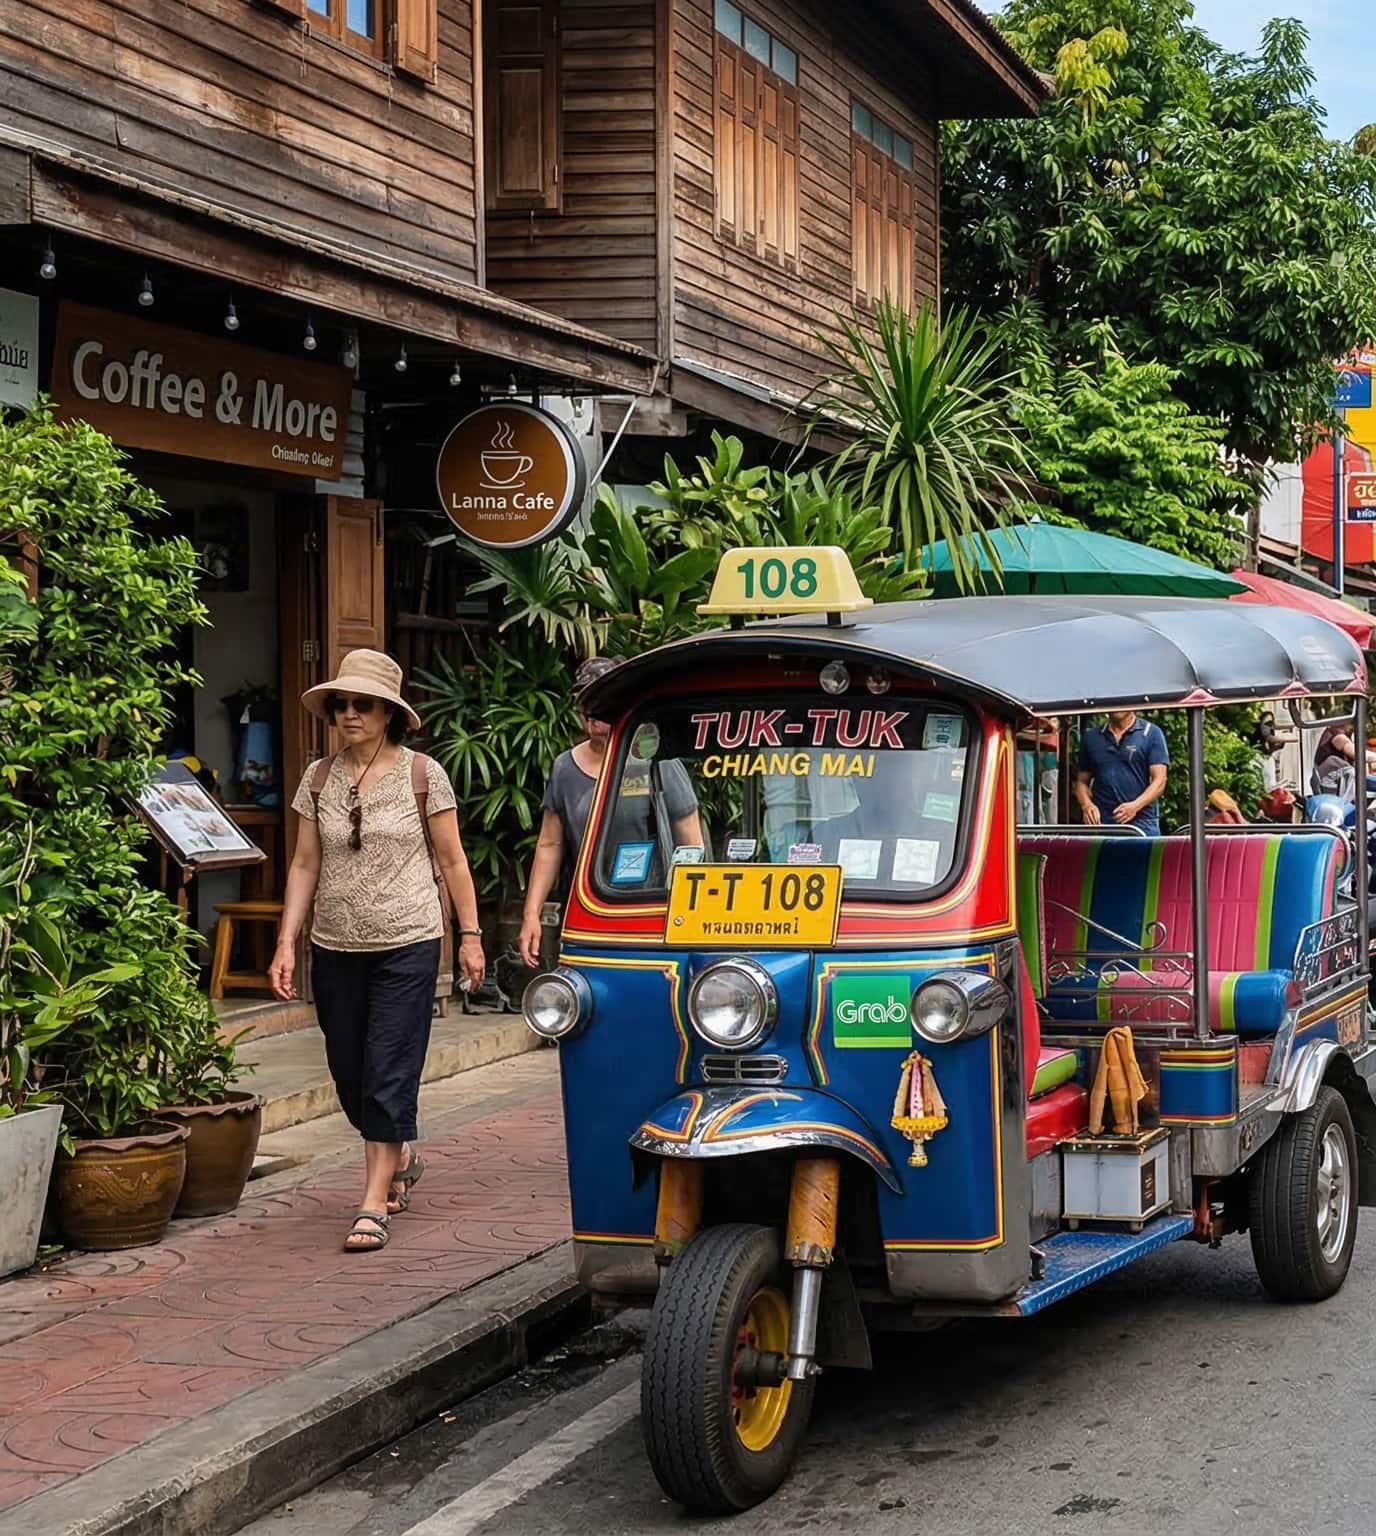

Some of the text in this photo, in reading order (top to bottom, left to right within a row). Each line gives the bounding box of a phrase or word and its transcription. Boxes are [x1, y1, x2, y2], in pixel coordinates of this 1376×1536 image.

[73, 341, 337, 442] Coffee & More
[452, 492, 554, 510] Lanna Cafe
[737, 558, 818, 598] 108
[691, 708, 910, 750] TUK-TUK
[703, 752, 876, 778] CHIANG MAI
[686, 873, 826, 912] T-T 108
[836, 995, 907, 1024] Grab
